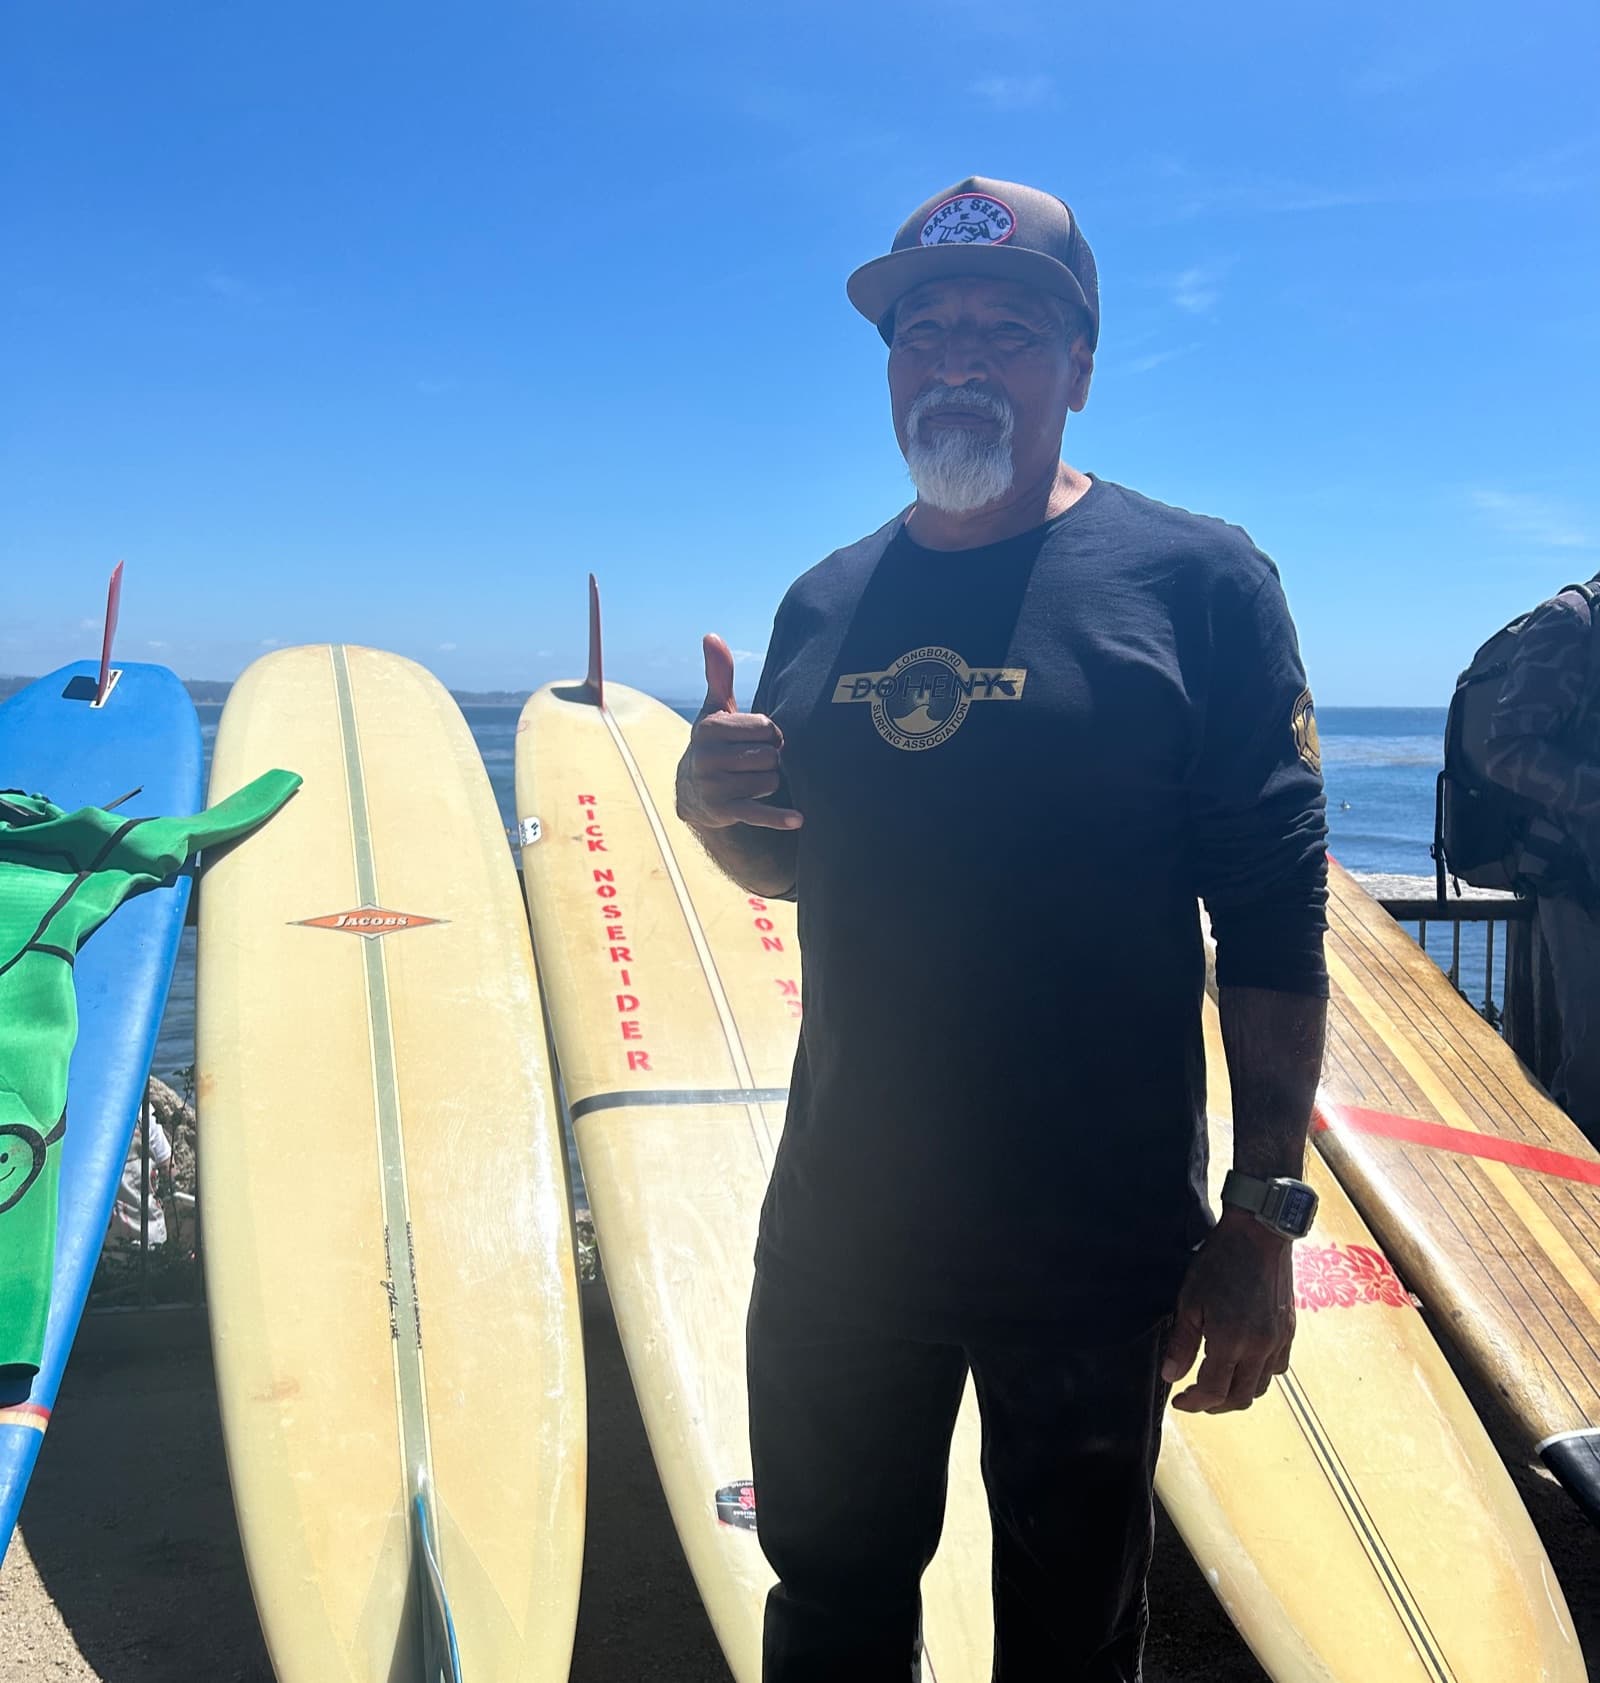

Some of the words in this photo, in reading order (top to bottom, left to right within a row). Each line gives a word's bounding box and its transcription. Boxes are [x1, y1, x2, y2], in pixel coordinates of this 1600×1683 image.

[923, 201, 964, 237] DARK
[970, 199, 1010, 230] SEAS
[895, 648, 962, 669] LONGBOARD
[852, 673, 1003, 699] DOHENY
[872, 703, 902, 745] SURFING
[902, 702, 968, 749] ASSOCIATION
[578, 794, 608, 852] RICK
[593, 868, 652, 1071] NOSERIDER
